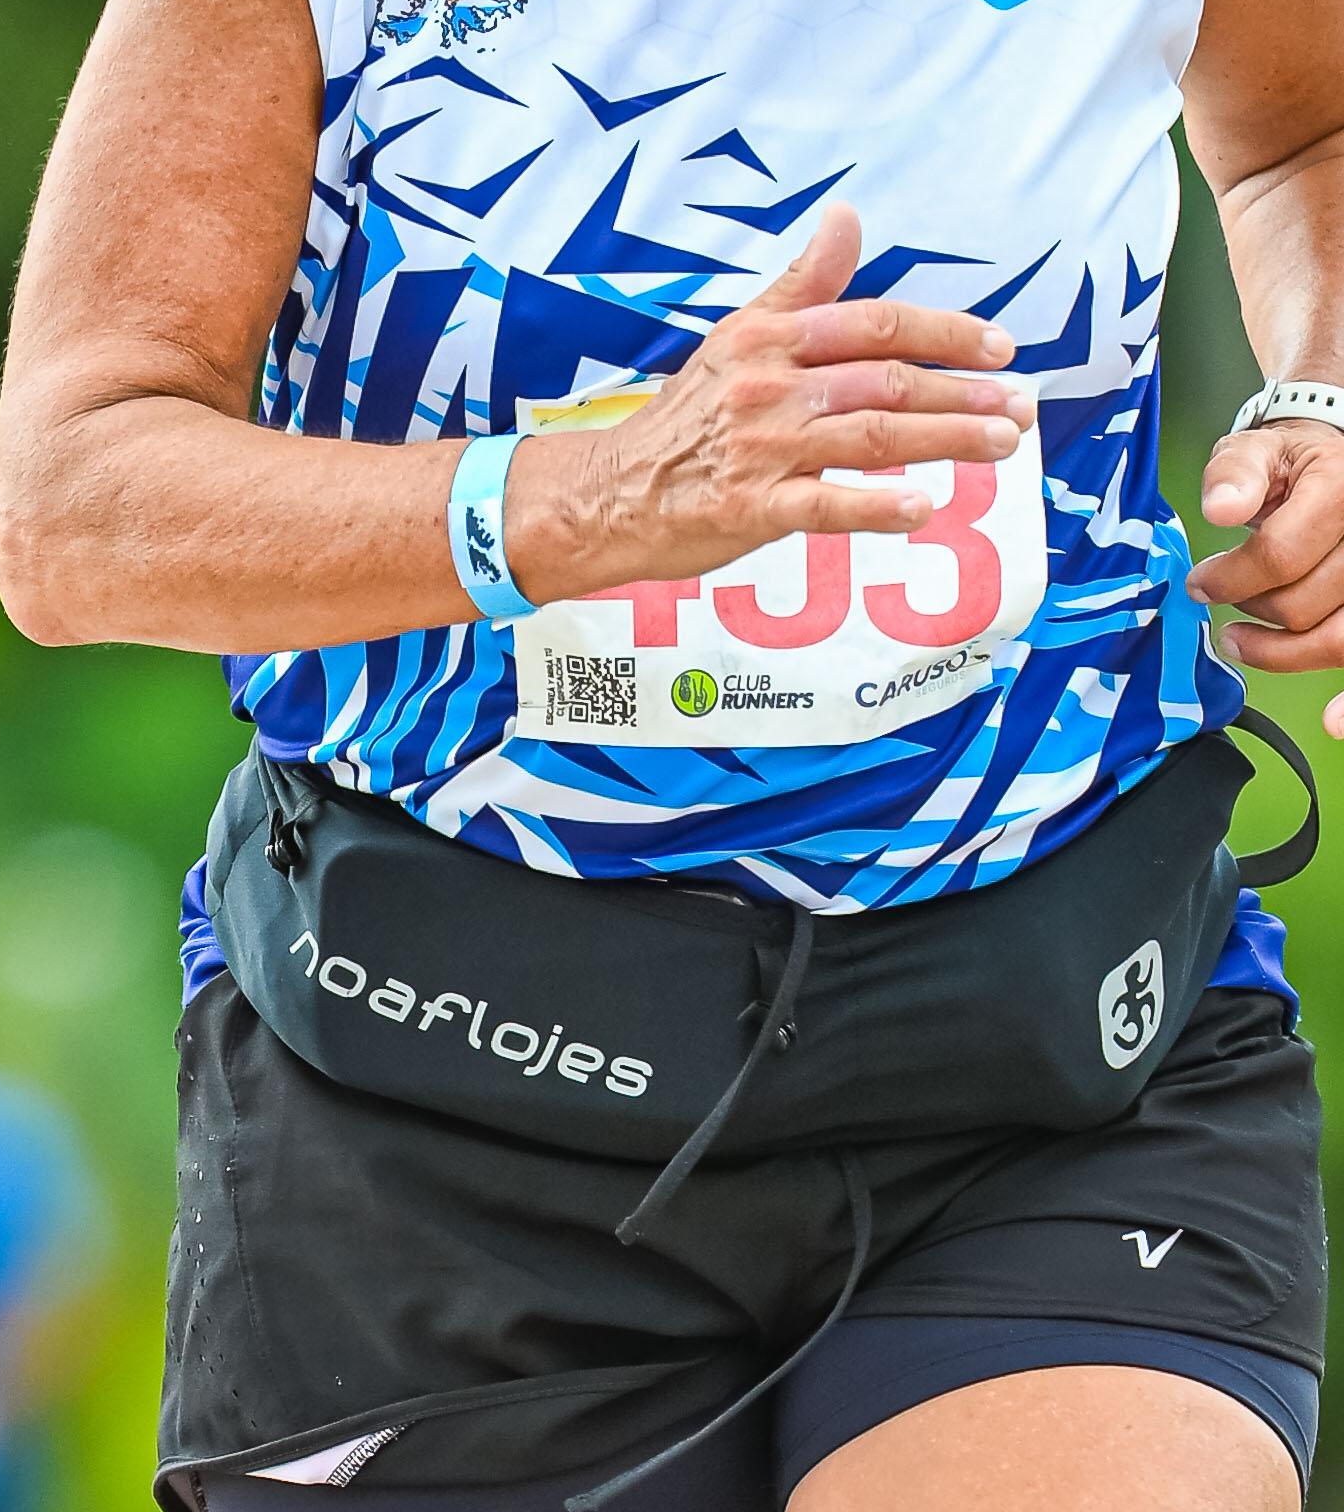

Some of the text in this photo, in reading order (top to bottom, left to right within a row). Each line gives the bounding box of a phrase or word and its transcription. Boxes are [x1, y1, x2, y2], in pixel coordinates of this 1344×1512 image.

[554, 657, 565, 717] CLSIFICACIÓN
[723, 674, 772, 692] CLUB
[855, 649, 968, 707] CARUSO
[915, 670, 967, 698] SEGUROS
[721, 692, 814, 710] RUNNER'S
